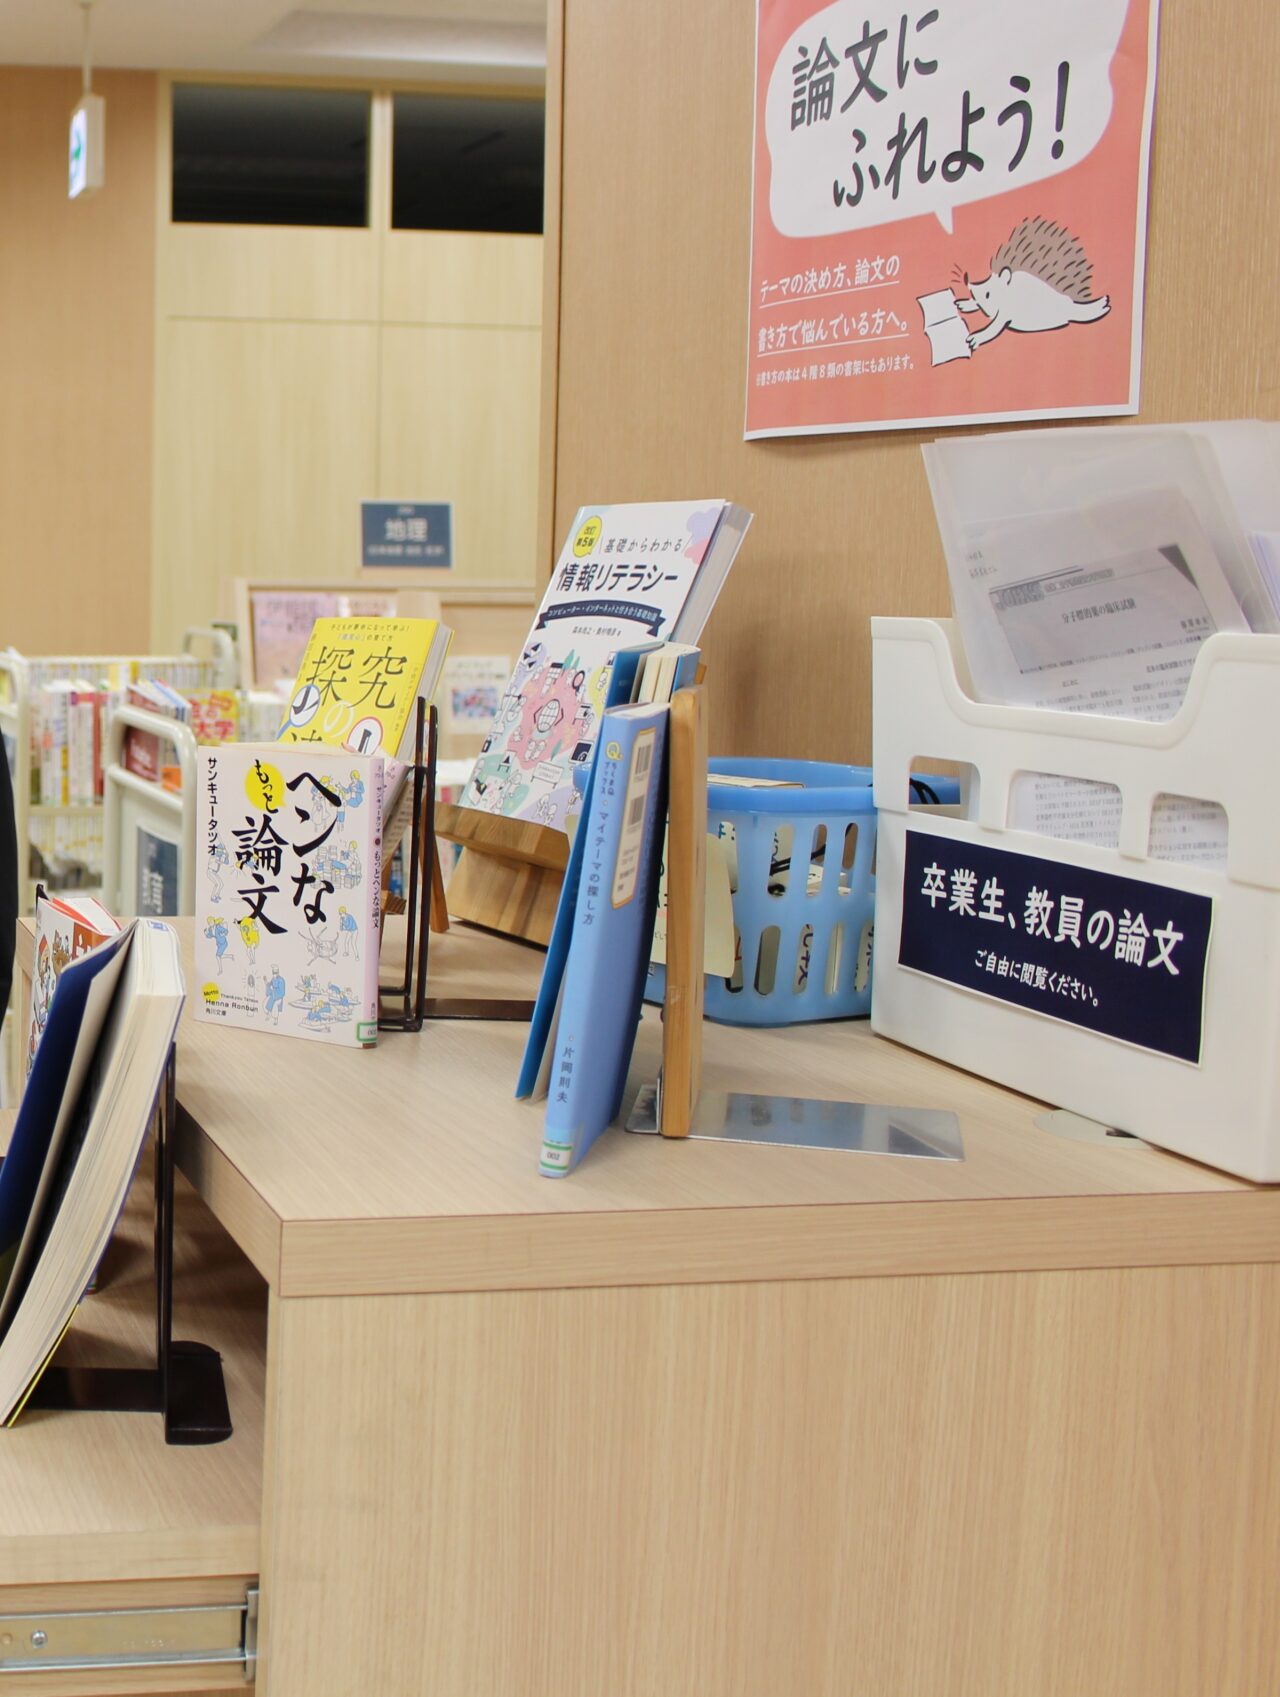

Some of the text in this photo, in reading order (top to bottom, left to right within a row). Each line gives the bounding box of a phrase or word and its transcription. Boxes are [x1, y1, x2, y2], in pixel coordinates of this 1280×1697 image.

[790, 9, 939, 131] 論文に
[833, 61, 1070, 208] ふれよう!
[760, 255, 900, 302] テーマの決め方、論文の
[757, 308, 907, 352] 書き方で悩んでいる方へ。
[556, 562, 679, 592] 情報リテラシー
[604, 538, 683, 553] 基礎からわかる
[291, 646, 408, 715] 探究
[207, 757, 218, 856] サンキュータツオ
[255, 759, 279, 814] もっと
[231, 813, 290, 935] 論文
[286, 772, 342, 924] ヘンな
[583, 812, 609, 925] マイテーマの探し方
[920, 862, 1184, 976] 卒業生、教員の論文
[205, 999, 259, 1012] Henna Ronbun
[974, 949, 1099, 1007] ご自由に閲覧ください。
